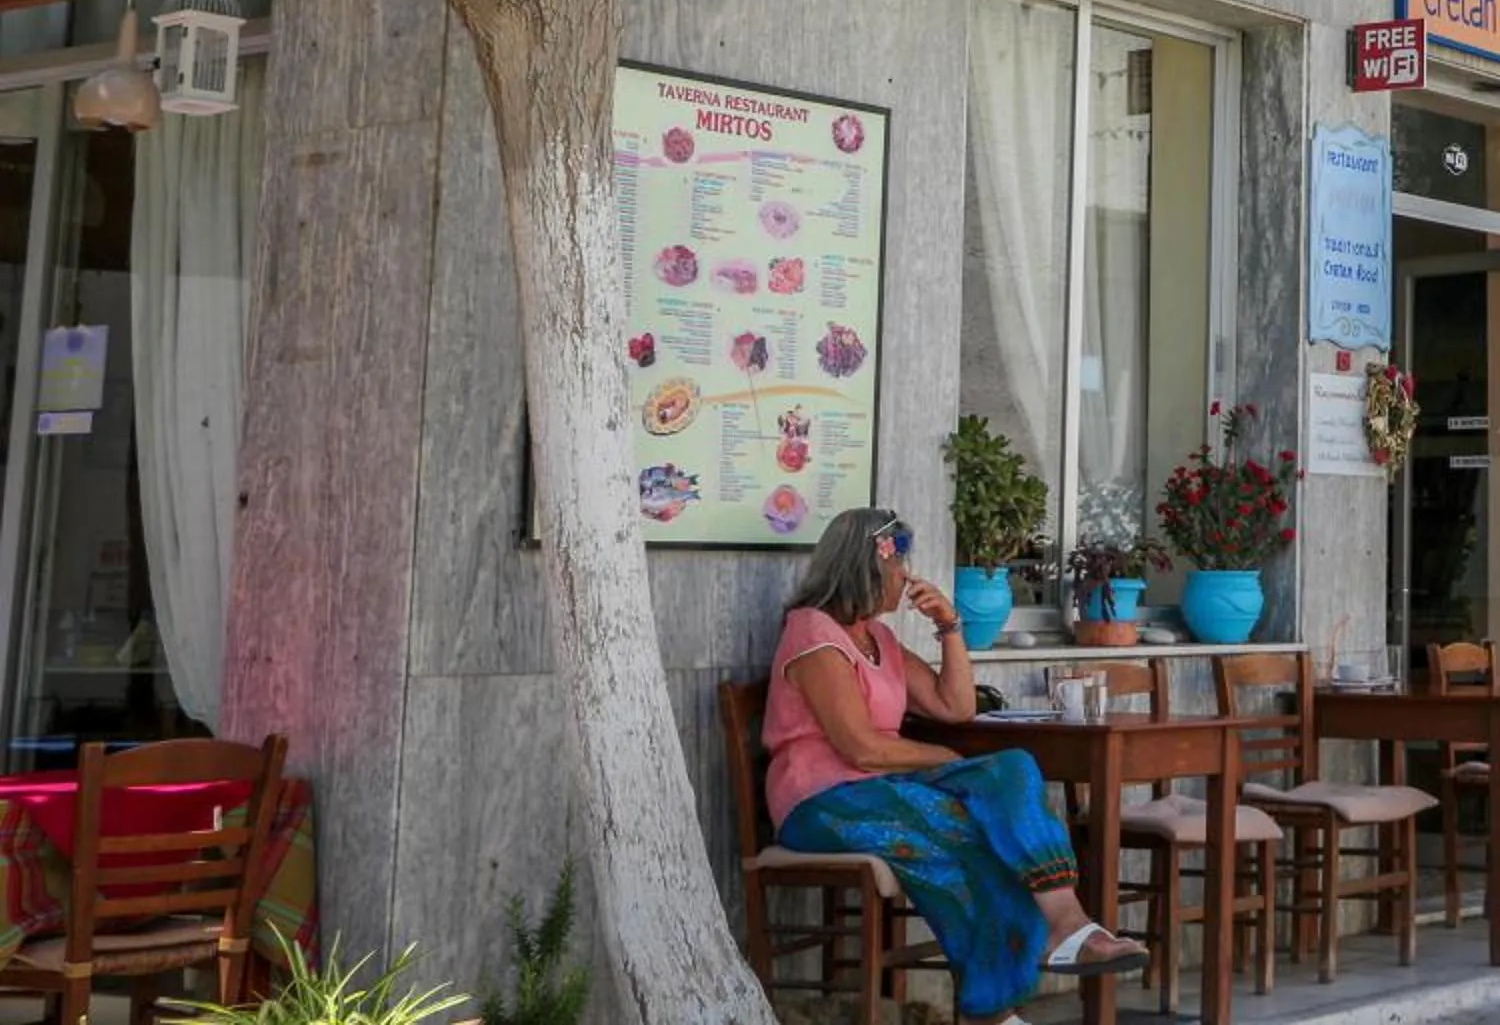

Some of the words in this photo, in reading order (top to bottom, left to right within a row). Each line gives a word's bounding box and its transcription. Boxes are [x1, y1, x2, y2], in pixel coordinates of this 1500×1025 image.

[1365, 26, 1416, 51] FREE
[657, 82, 721, 107] TAVERNA
[725, 95, 809, 124] RESTAURANT
[696, 109, 774, 142] MIRTOS
